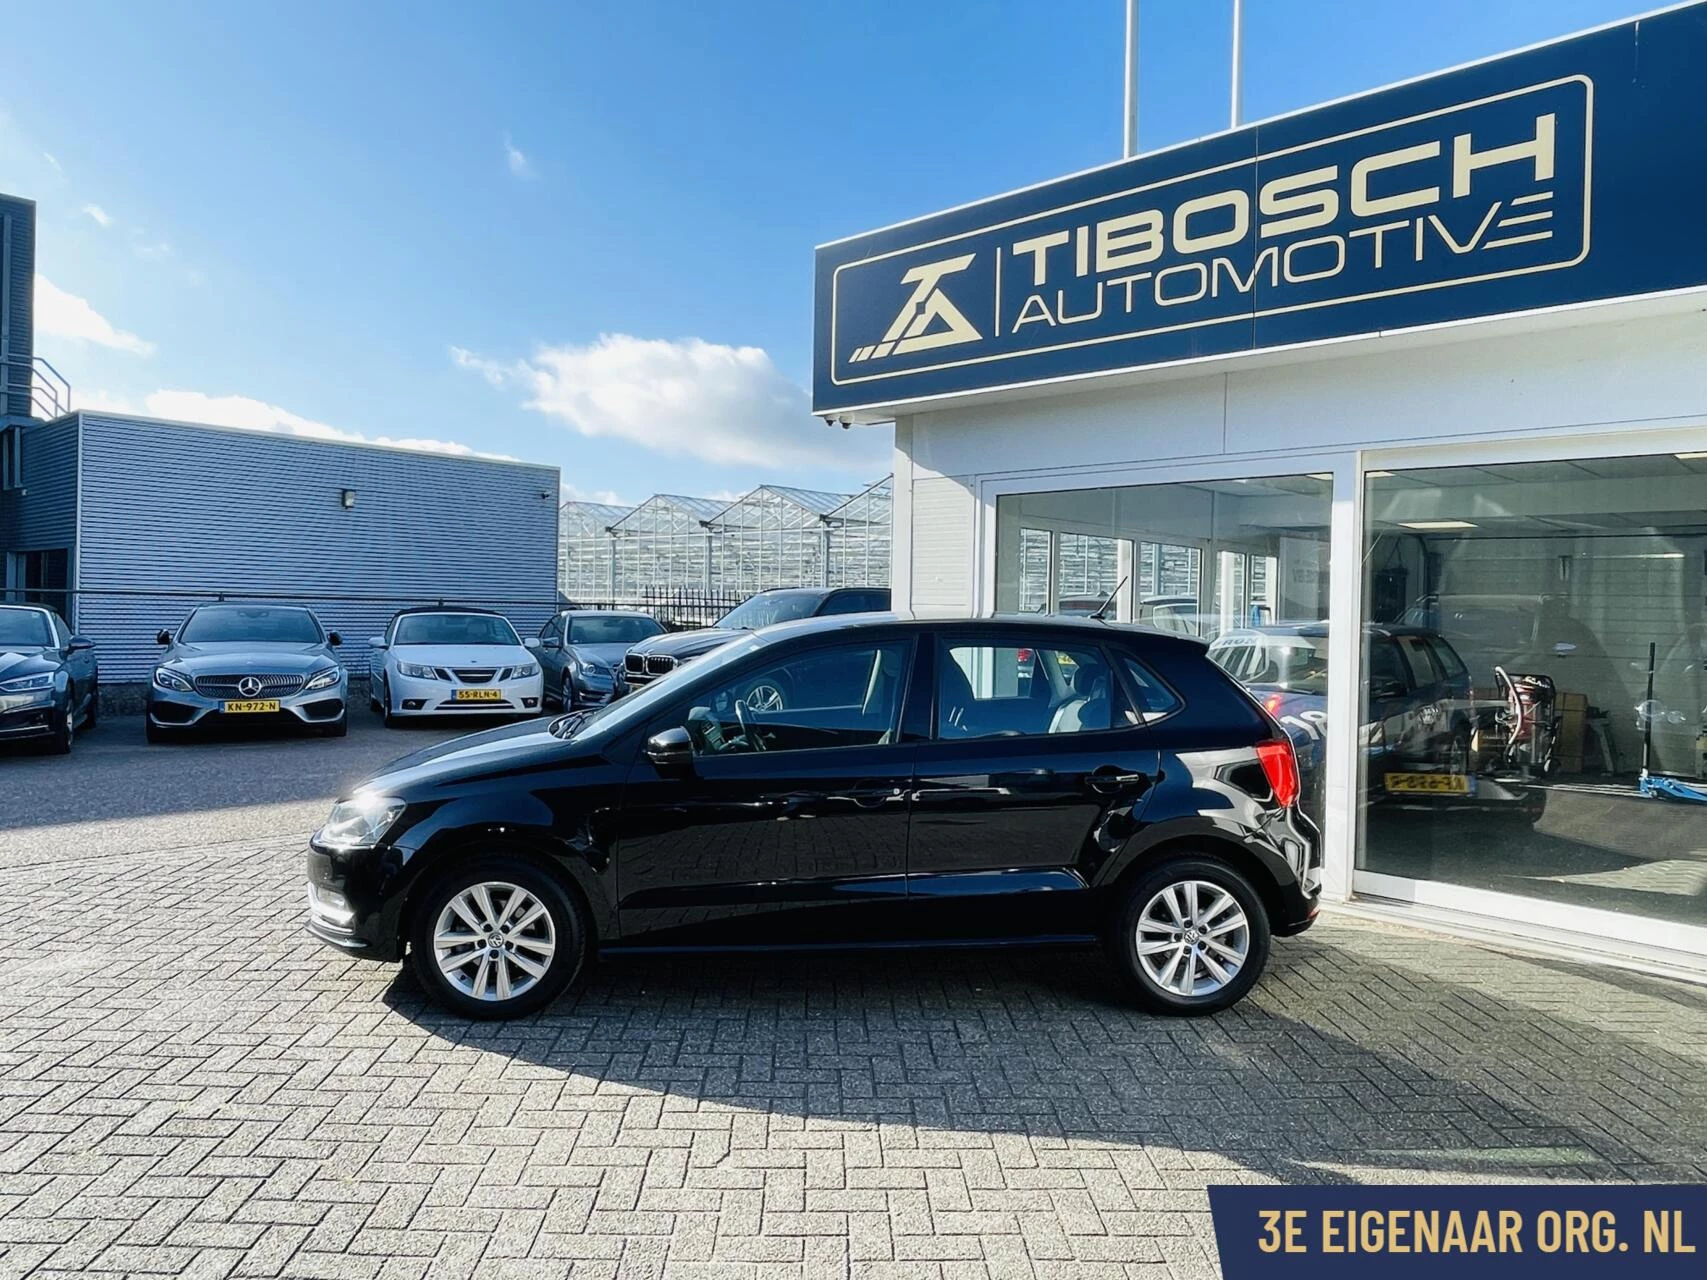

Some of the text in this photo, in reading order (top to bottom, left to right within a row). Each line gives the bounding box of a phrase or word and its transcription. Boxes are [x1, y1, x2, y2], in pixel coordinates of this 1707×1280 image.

[1012, 113, 1556, 286] TIBOSCH
[1011, 191, 1554, 334] AUTOMOTIVE
[227, 702, 276, 711] KN-972-N
[458, 690, 498, 699] 55-RLN-4
